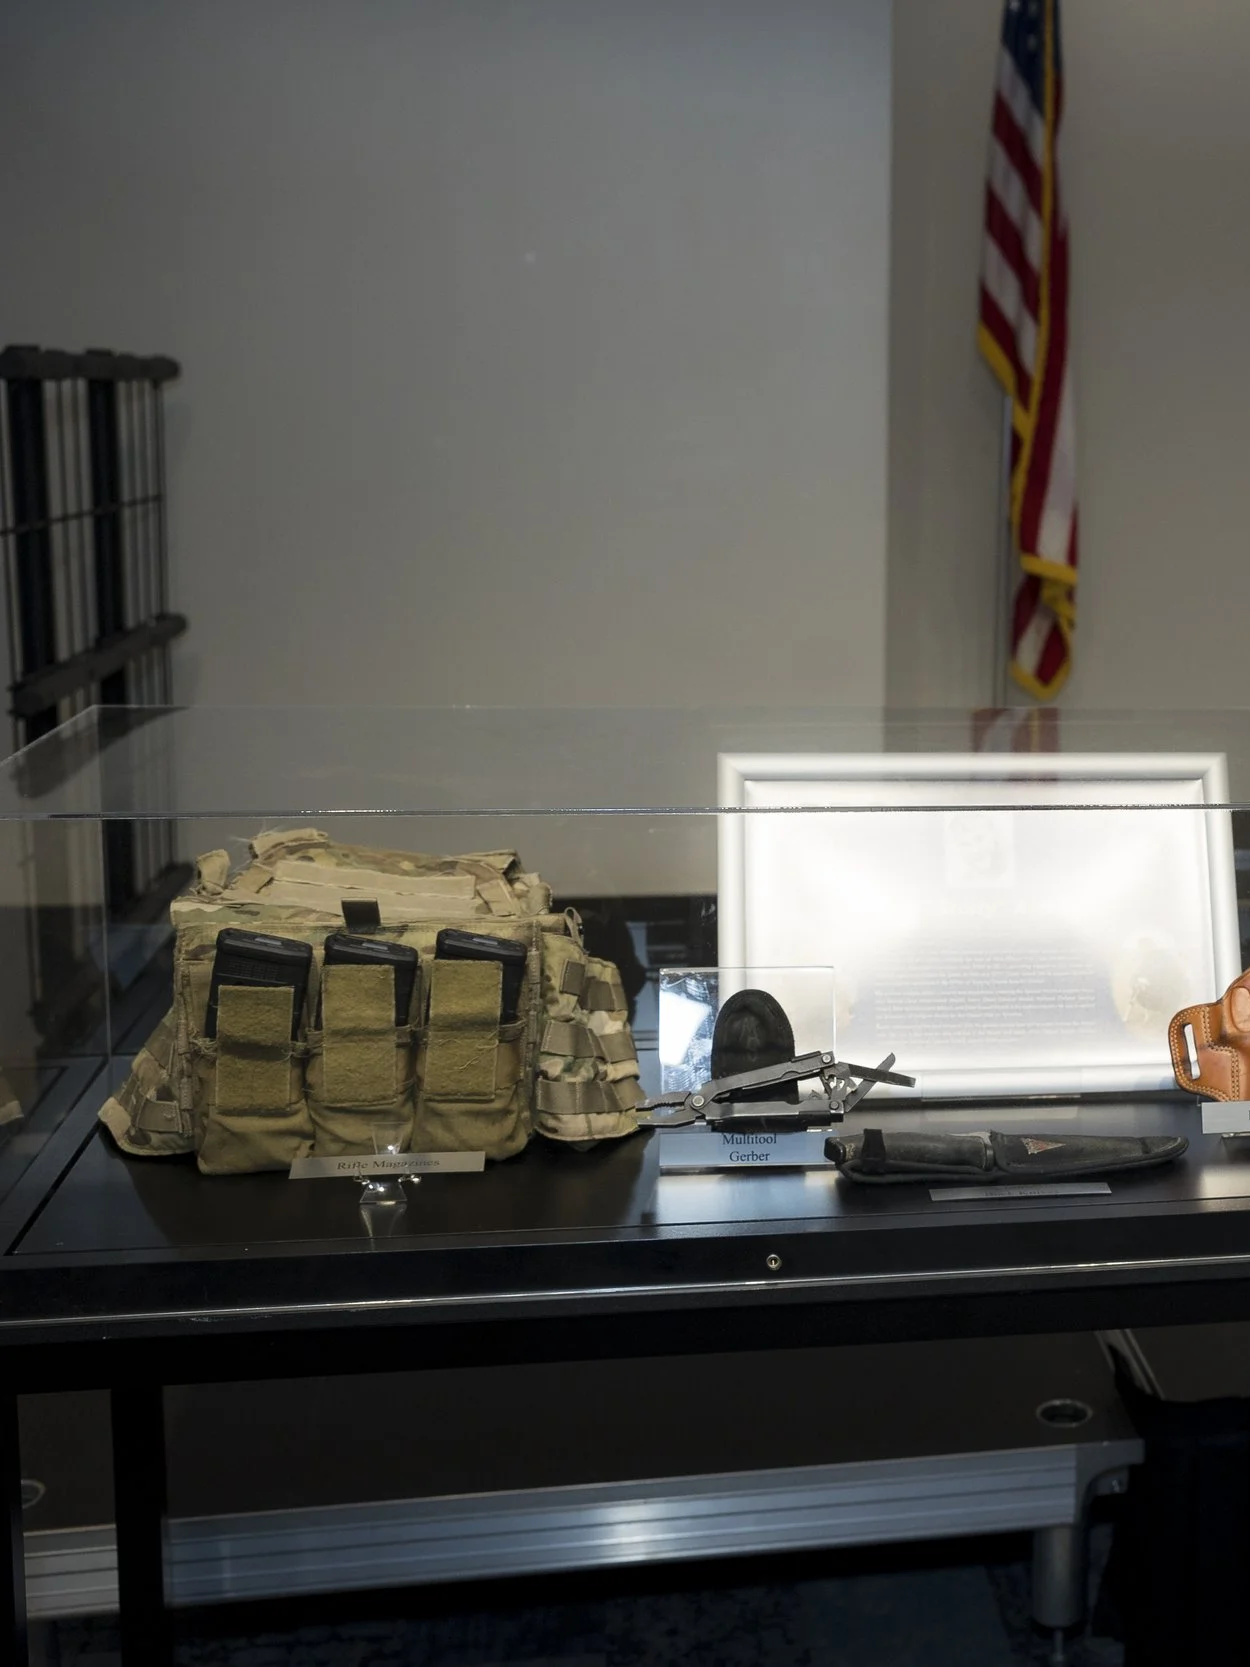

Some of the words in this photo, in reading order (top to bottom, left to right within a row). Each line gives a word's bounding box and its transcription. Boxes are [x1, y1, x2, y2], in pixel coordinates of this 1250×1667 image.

[723, 1133, 777, 1145] Multitool
[729, 1151, 770, 1162] Gerber
[337, 1160, 368, 1171] Rifle
[373, 1158, 441, 1170] Magazines
